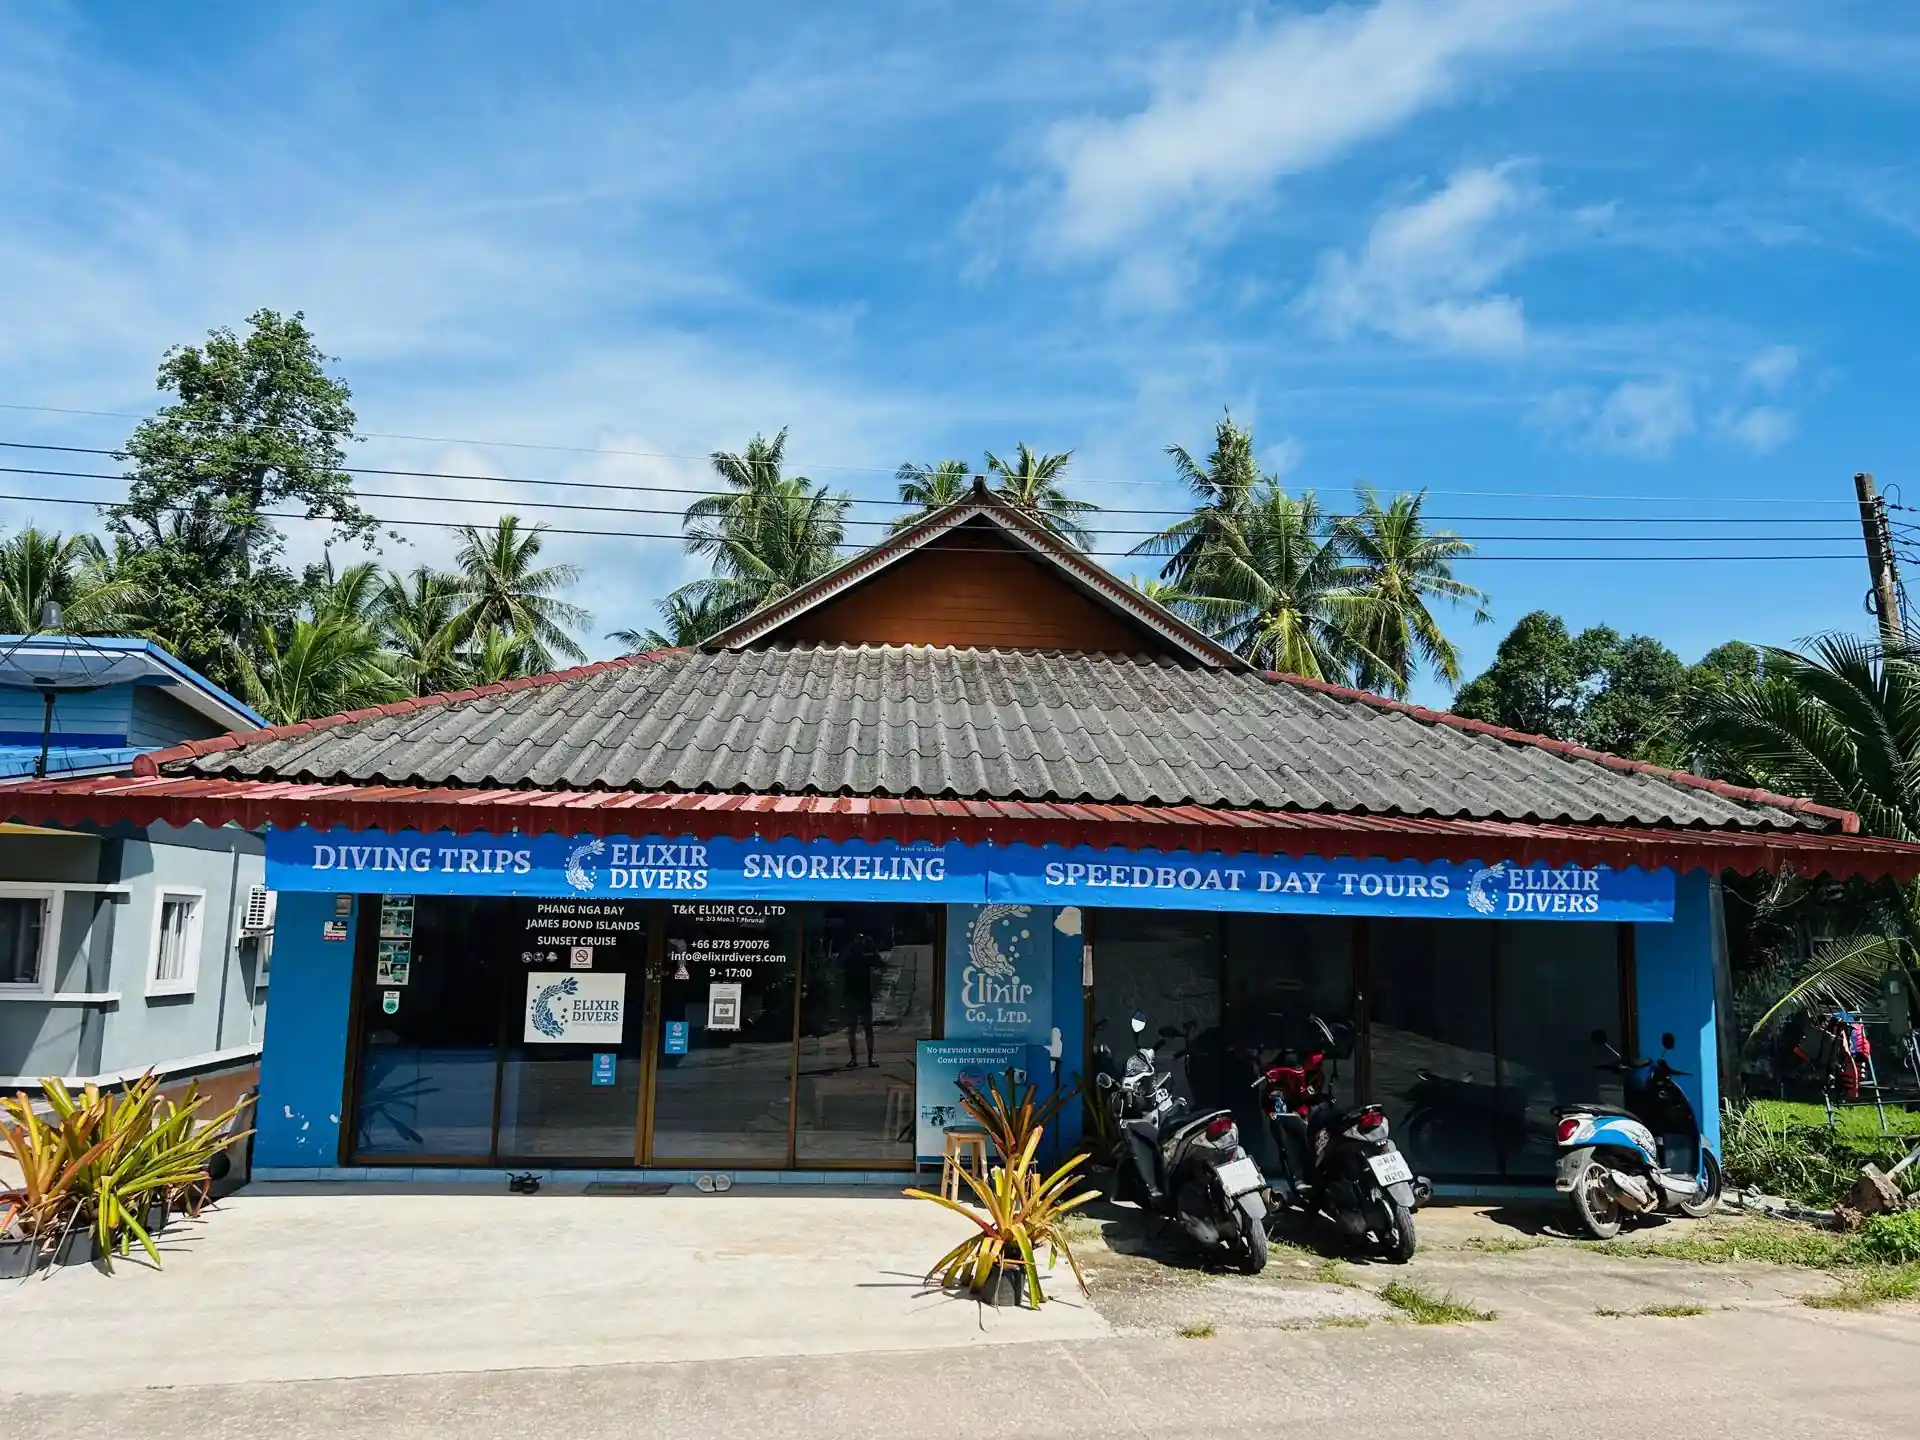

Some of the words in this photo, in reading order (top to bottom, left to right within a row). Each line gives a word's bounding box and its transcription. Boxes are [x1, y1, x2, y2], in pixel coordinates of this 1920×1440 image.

[312, 845, 431, 873] DIVING
[438, 848, 531, 874] TRIPS
[610, 843, 709, 867] ELIXIR
[743, 854, 945, 881] SNORKELING
[609, 868, 708, 890] DIVERS
[1045, 862, 1246, 892] SPEEDBOAT
[1257, 870, 1326, 894] DAY
[1338, 873, 1450, 898] TOURS
[1507, 869, 1600, 891] ELIXIR
[1506, 892, 1599, 913] DIVERS
[537, 904, 575, 914] PHANG
[578, 905, 601, 915] NGA
[604, 906, 625, 916] BAY
[672, 904, 696, 915] T&K
[699, 905, 735, 915] ELIXIR
[764, 905, 786, 916] LTD
[525, 918, 559, 930] JAMES
[562, 919, 593, 930] BOND
[596, 920, 640, 931] ISLANDS
[537, 935, 578, 946] SUNSET
[580, 936, 617, 946] CRUISE
[691, 939, 710, 949] +66
[712, 940, 731, 949] 878
[733, 940, 770, 949] 970076
[671, 951, 787, 963] info@elixirdivers.com
[709, 968, 716, 977] 9
[725, 968, 752, 978] 17:00
[961, 966, 1033, 1008] Elixir
[573, 999, 620, 1011] ELIXIR
[572, 1011, 619, 1022] DIVERS
